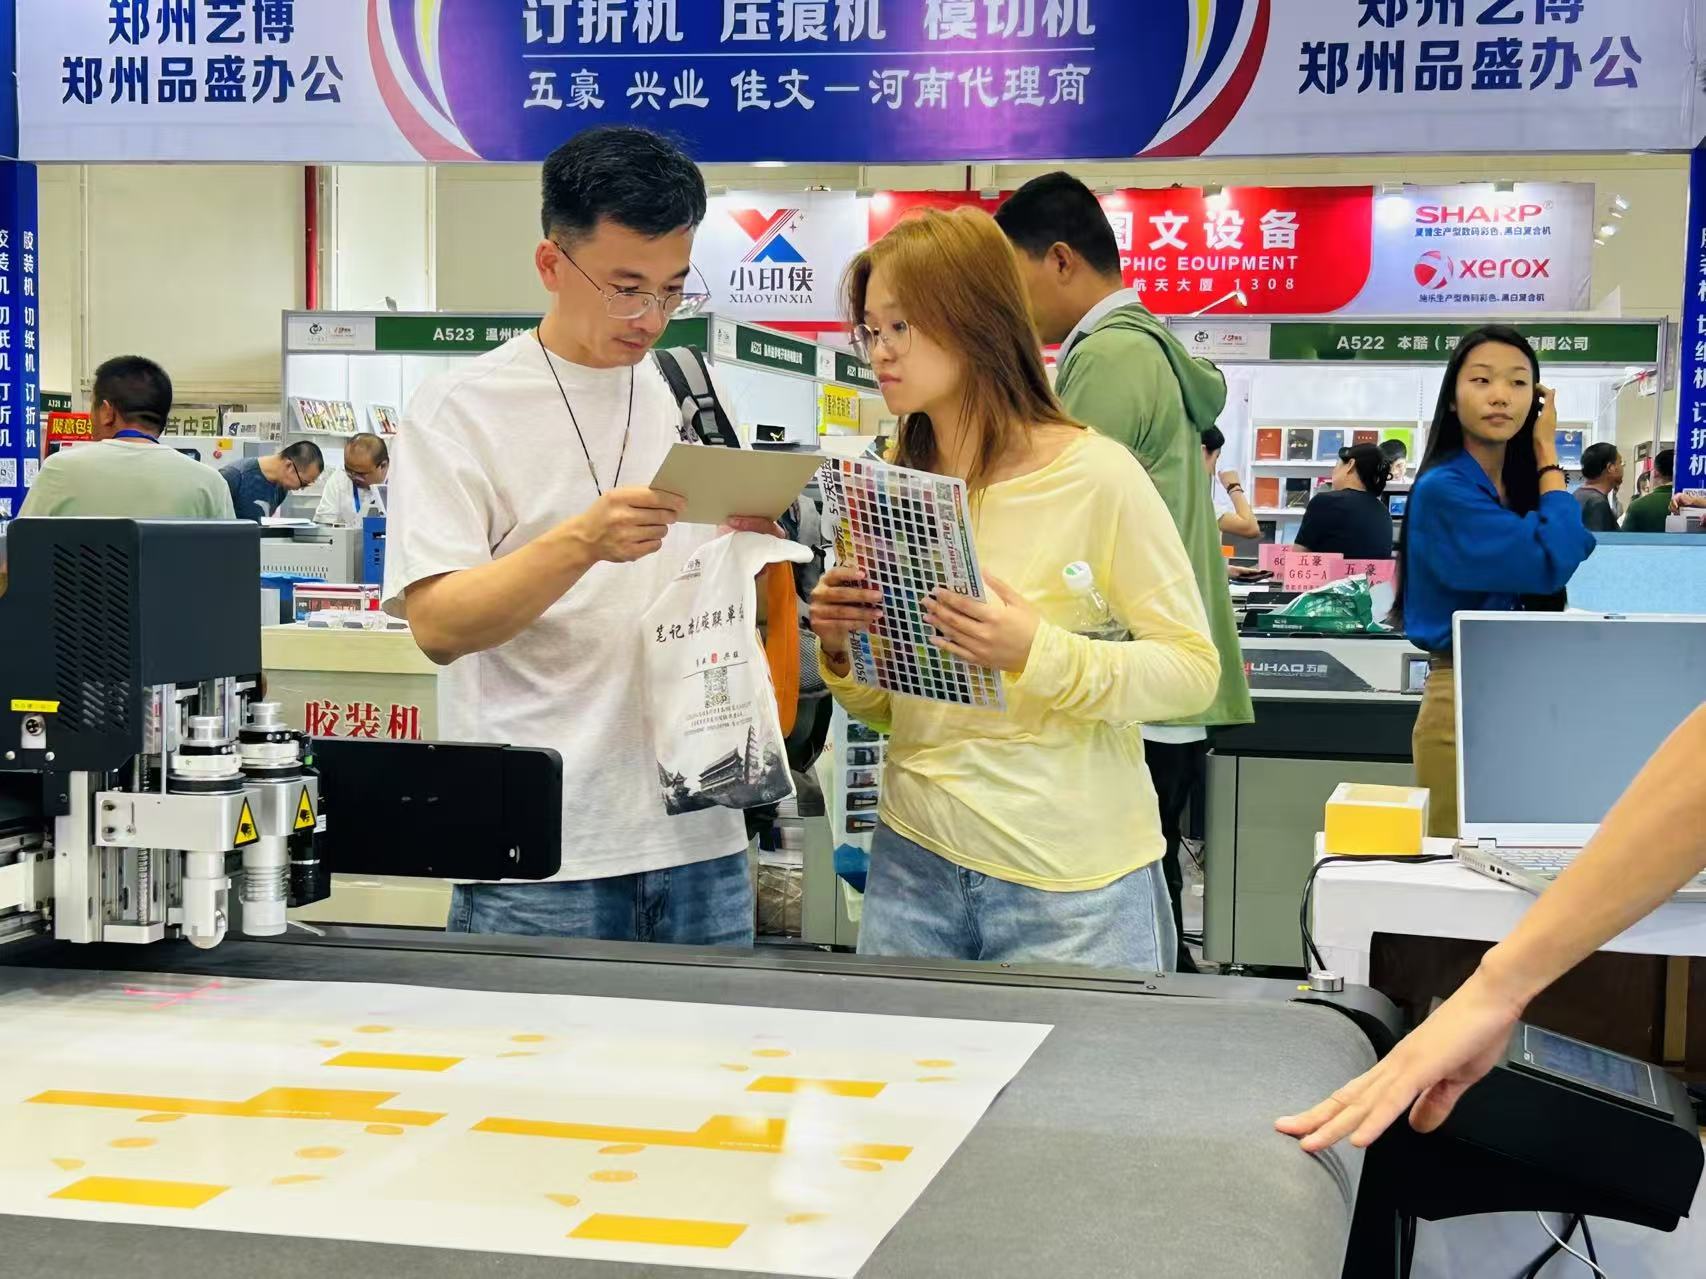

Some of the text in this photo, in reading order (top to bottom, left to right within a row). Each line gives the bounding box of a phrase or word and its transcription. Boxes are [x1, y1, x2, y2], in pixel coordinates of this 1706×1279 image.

[108, 0, 295, 46] 郑州艺博
[522, 0, 1096, 45] 订折机 压痕机 模切机
[1298, 35, 1643, 95] 郑州品盛办公
[62, 54, 344, 105] 郑州品盛办公
[523, 68, 605, 110] 五豪
[626, 70, 710, 110] 兴业
[1415, 205, 1543, 224] SHARP
[729, 266, 814, 292] 小印侠
[1459, 258, 1550, 279] xerox
[1233, 278, 1295, 291] 1308
[729, 294, 813, 304] XIAOYINXIA
[433, 328, 475, 341] A523
[1336, 336, 1385, 350] A522
[1299, 555, 1323, 567] 五豪
[304, 700, 422, 741] 胶装机
